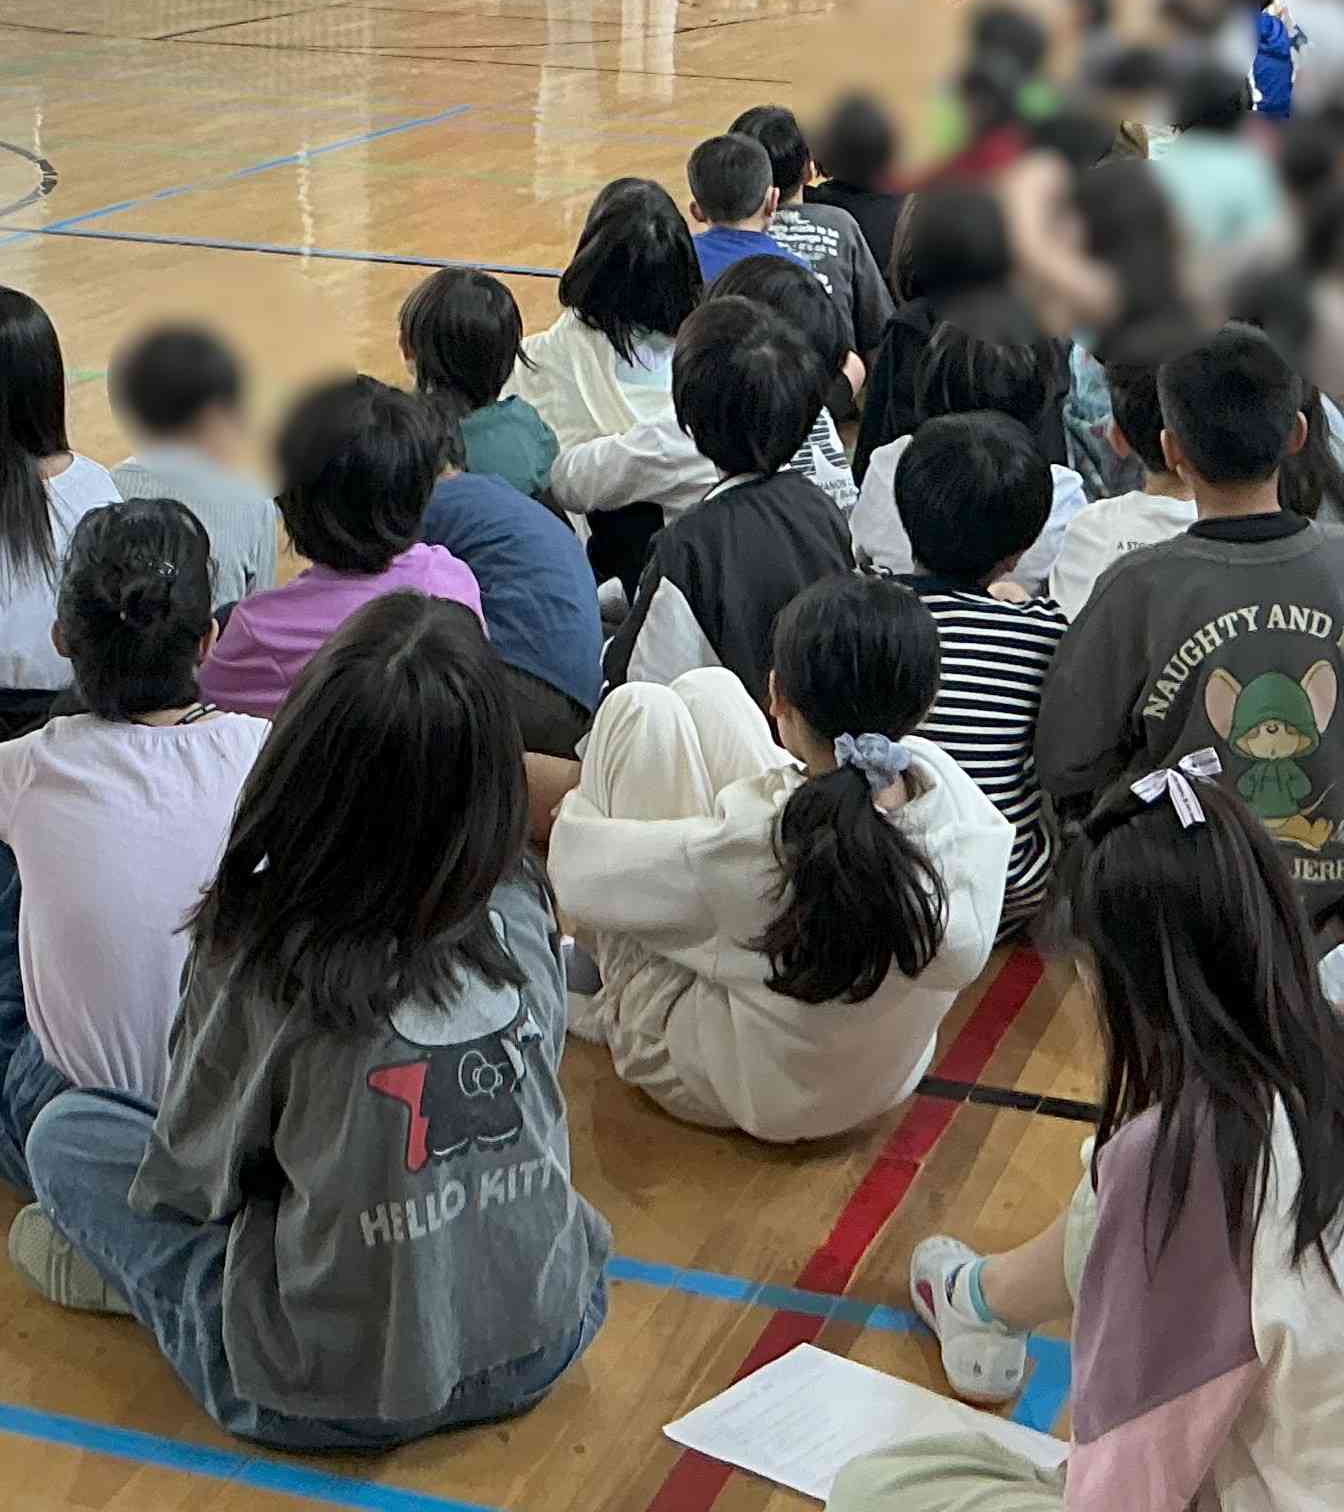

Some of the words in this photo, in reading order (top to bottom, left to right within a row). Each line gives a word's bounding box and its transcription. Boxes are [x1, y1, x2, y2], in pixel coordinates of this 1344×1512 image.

[1142, 605, 1261, 721] NAUGHTY
[1266, 603, 1333, 639] AND
[359, 1179, 466, 1247] HELLO
